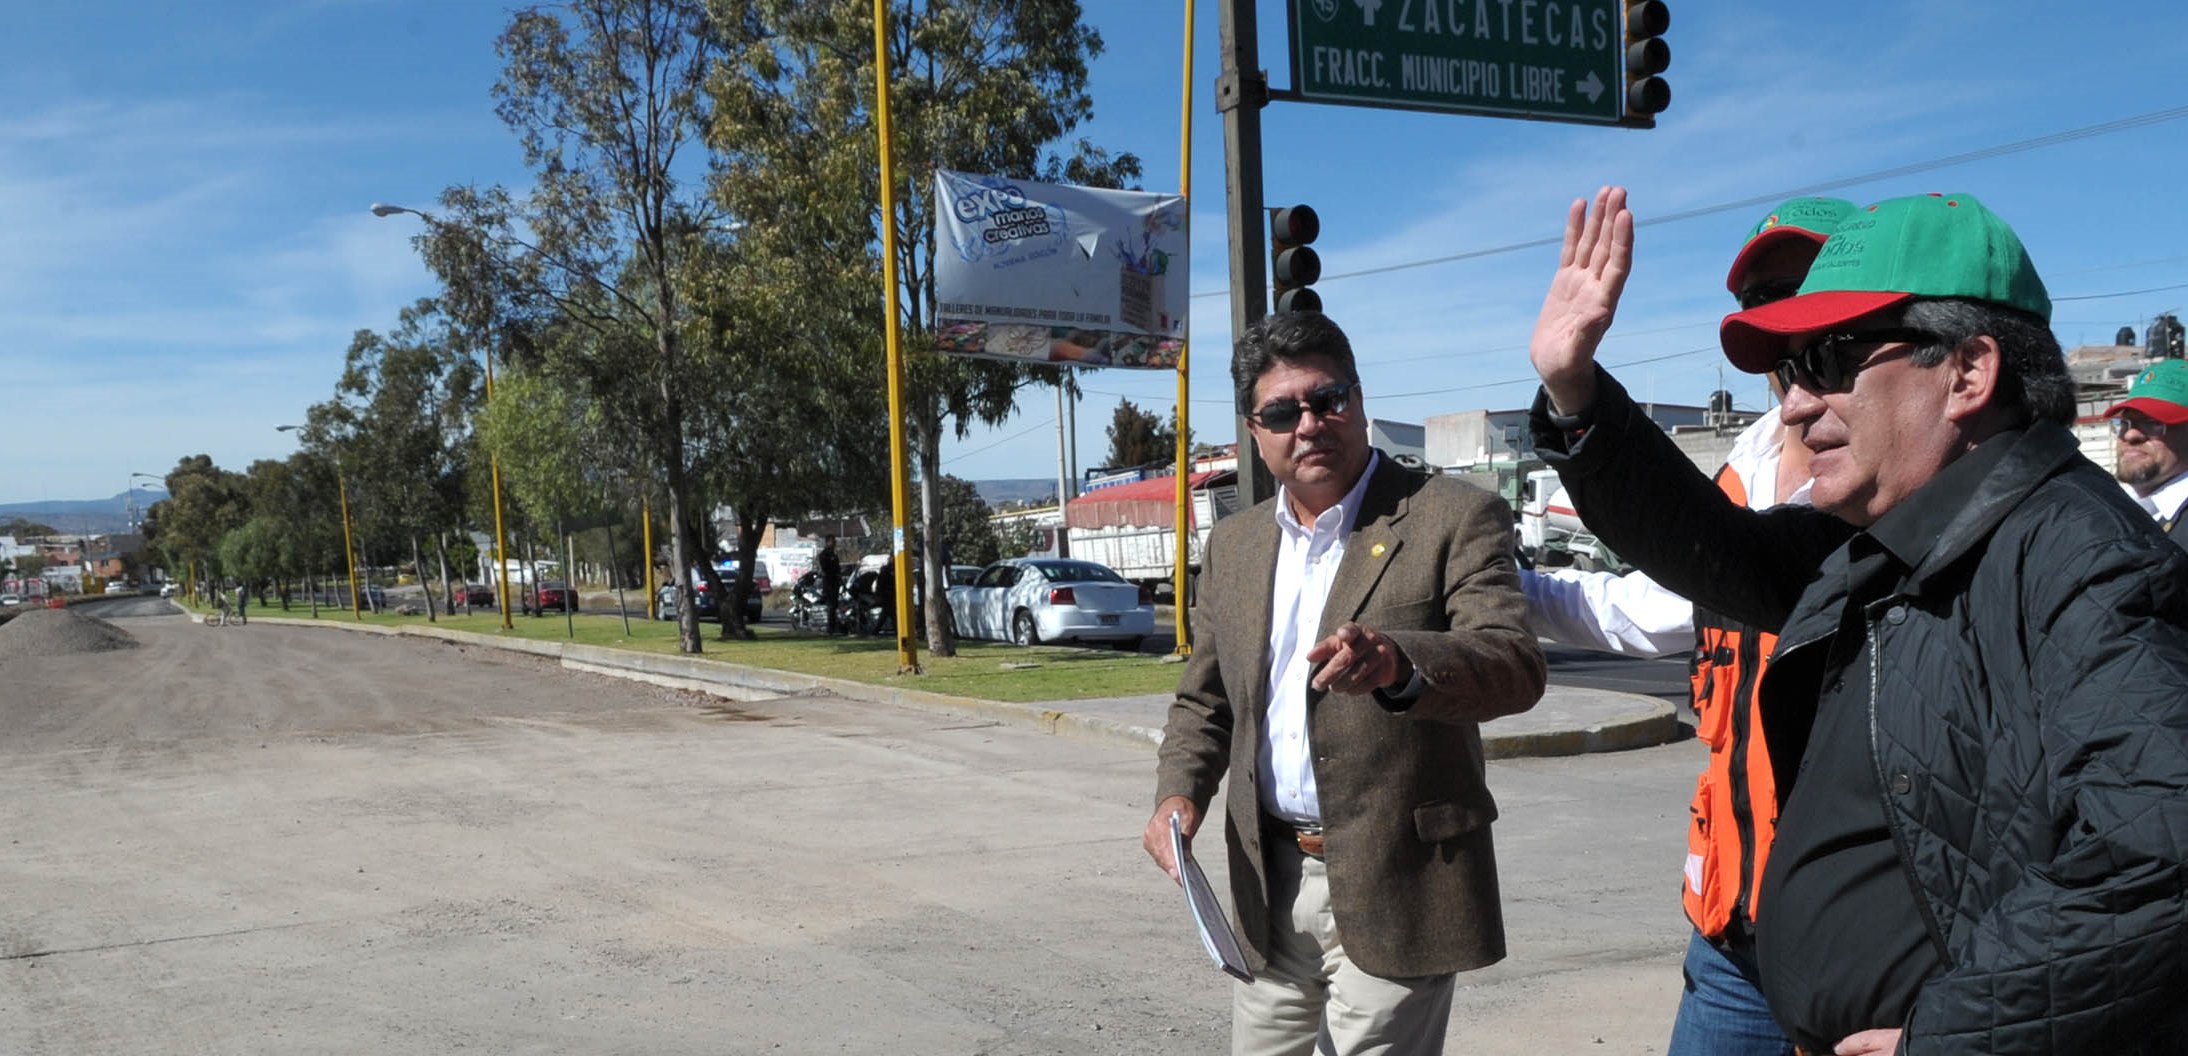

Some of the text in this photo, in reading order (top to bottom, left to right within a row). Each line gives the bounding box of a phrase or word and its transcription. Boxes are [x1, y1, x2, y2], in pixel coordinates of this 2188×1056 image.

[1398, 0, 1607, 51] ZACATECAS
[1313, 46, 1566, 104] FRACC. MUNICIPIO LIBRE
[985, 221, 1051, 242] creativas
[994, 207, 1045, 226] manos
